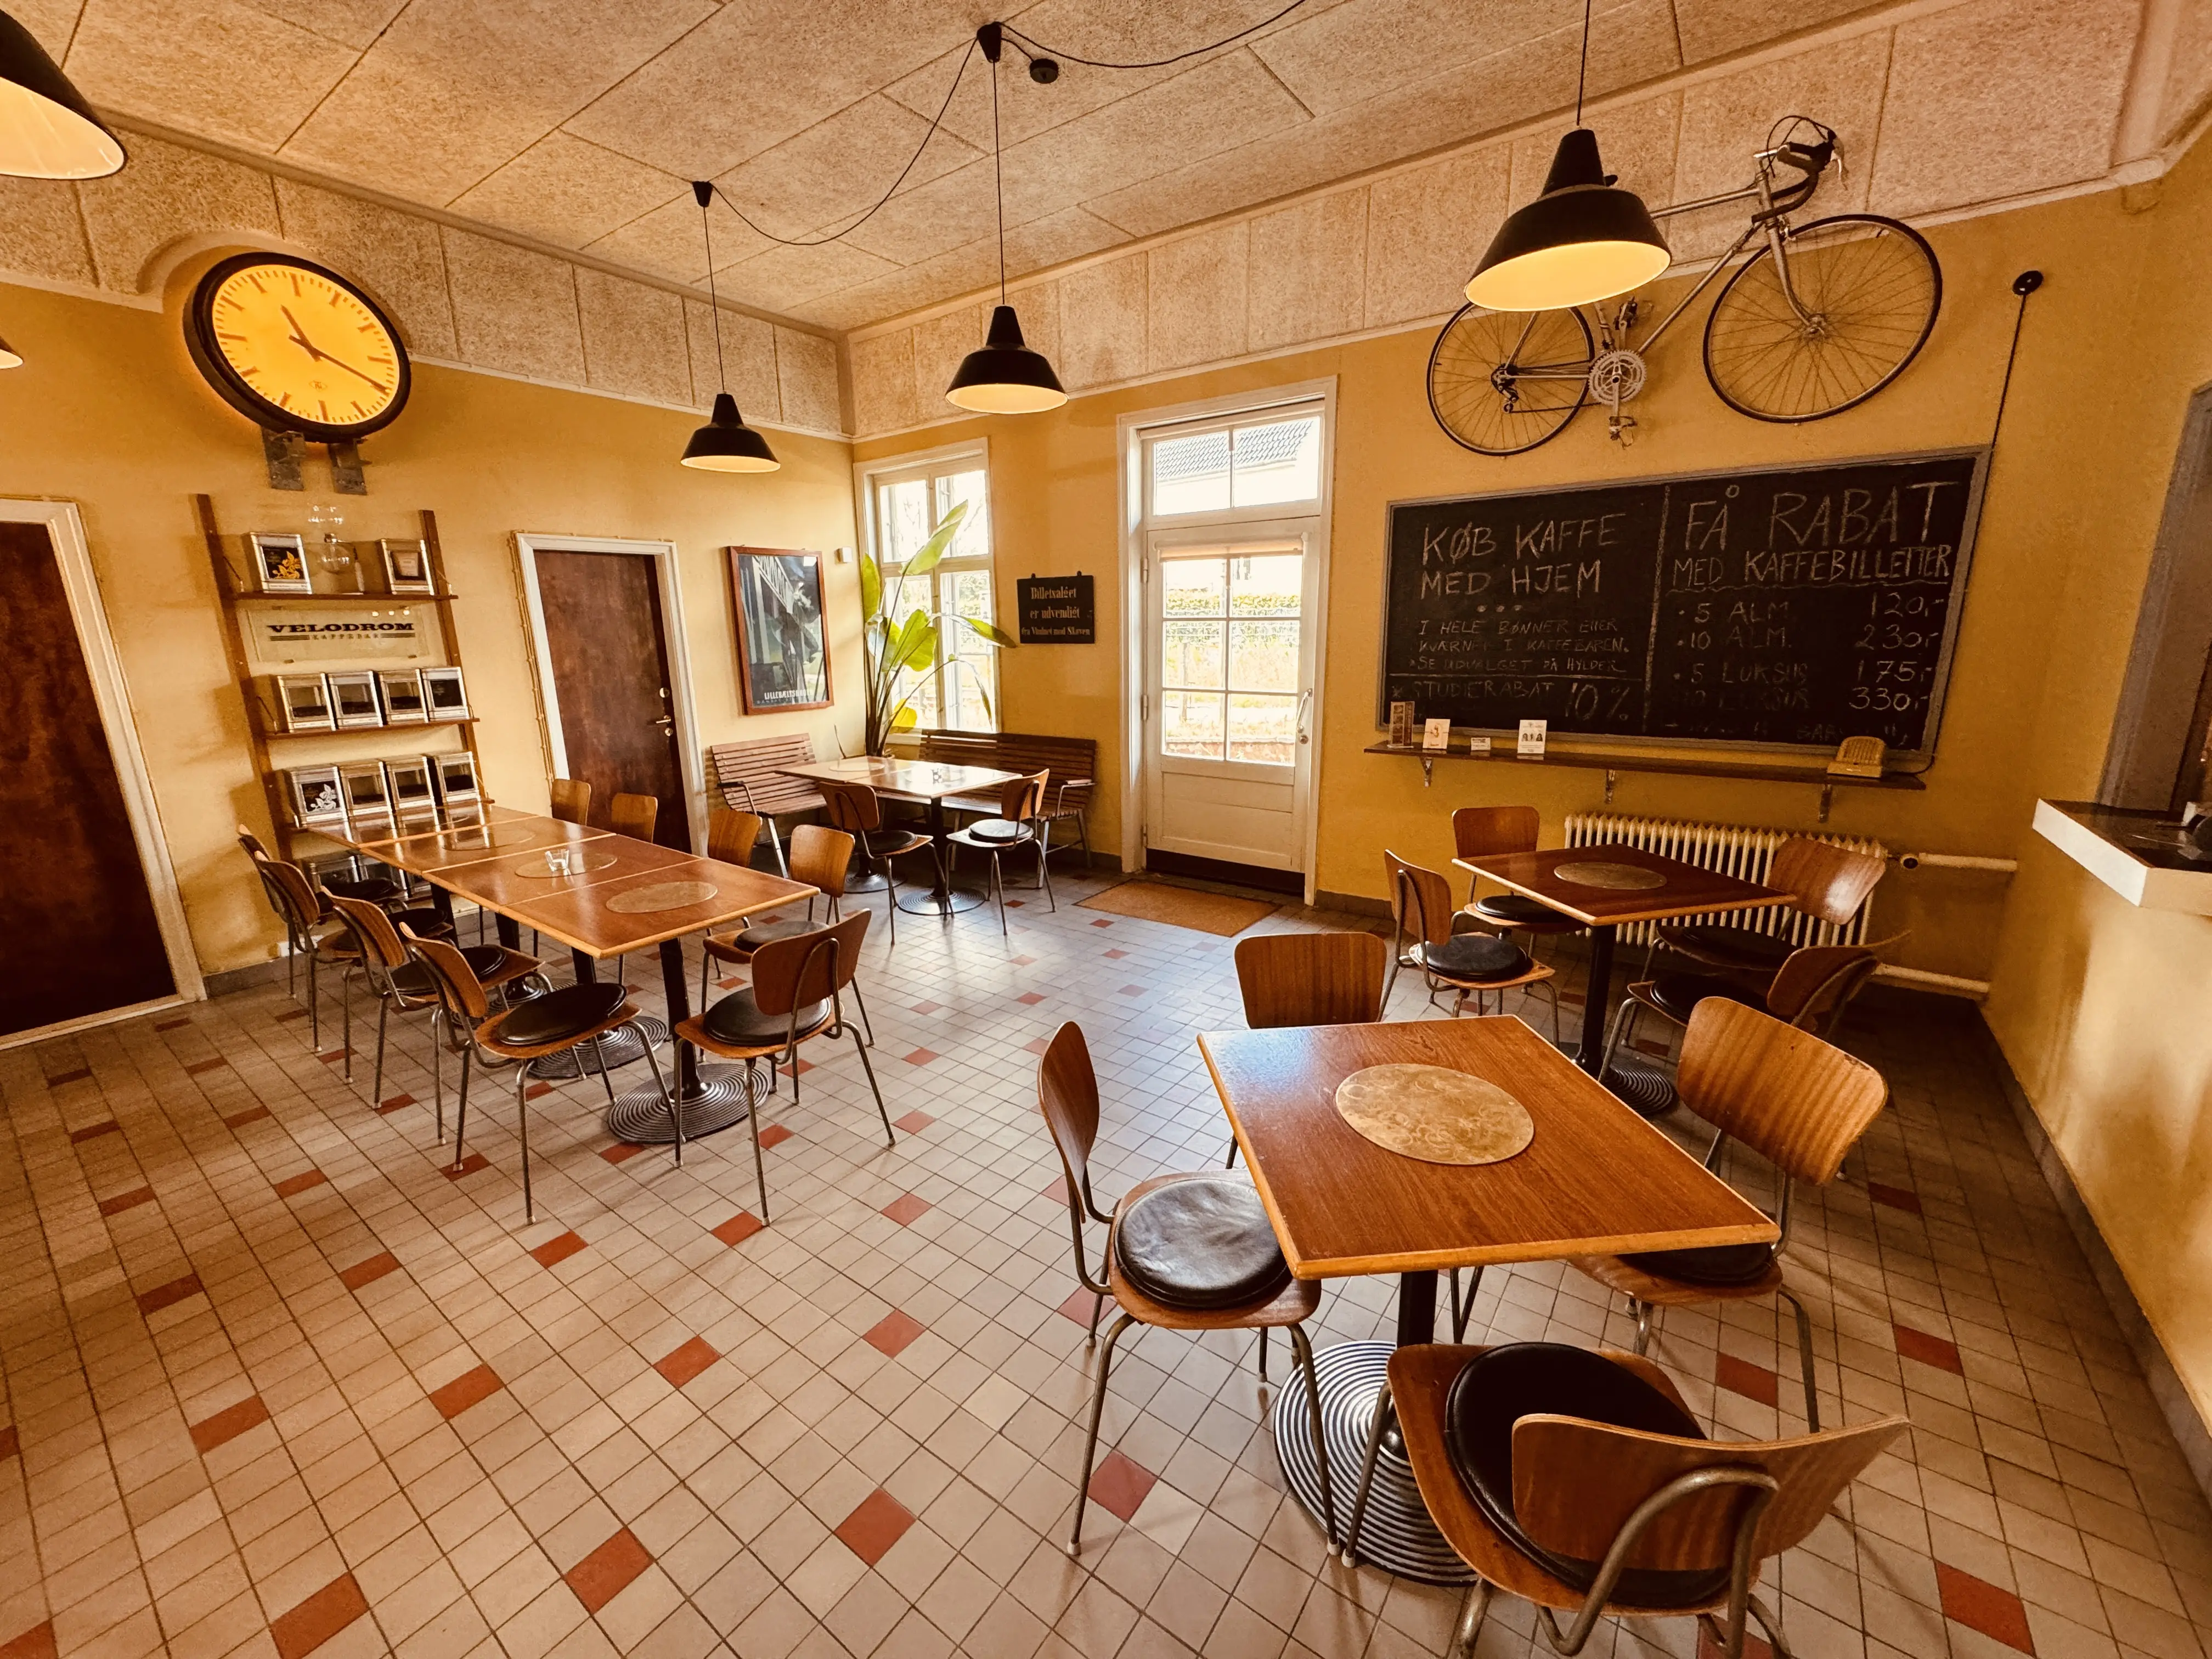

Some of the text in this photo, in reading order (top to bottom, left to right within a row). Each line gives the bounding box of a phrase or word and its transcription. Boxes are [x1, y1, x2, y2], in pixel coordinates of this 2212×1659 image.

[1685, 481, 1960, 550] FÅ RABAT
[1422, 513, 1626, 566] KØB KAFFE
[1420, 559, 1601, 600] MED HJEM
[1673, 544, 1951, 587] MED KAFFEBILLETTER
[267, 623, 415, 633] VELODROM
[1419, 620, 1430, 635] I
[1440, 620, 1487, 634] HELE
[1498, 619, 1568, 635] BØNNER
[1695, 603, 1711, 623] 5
[1691, 631, 1711, 650] 10
